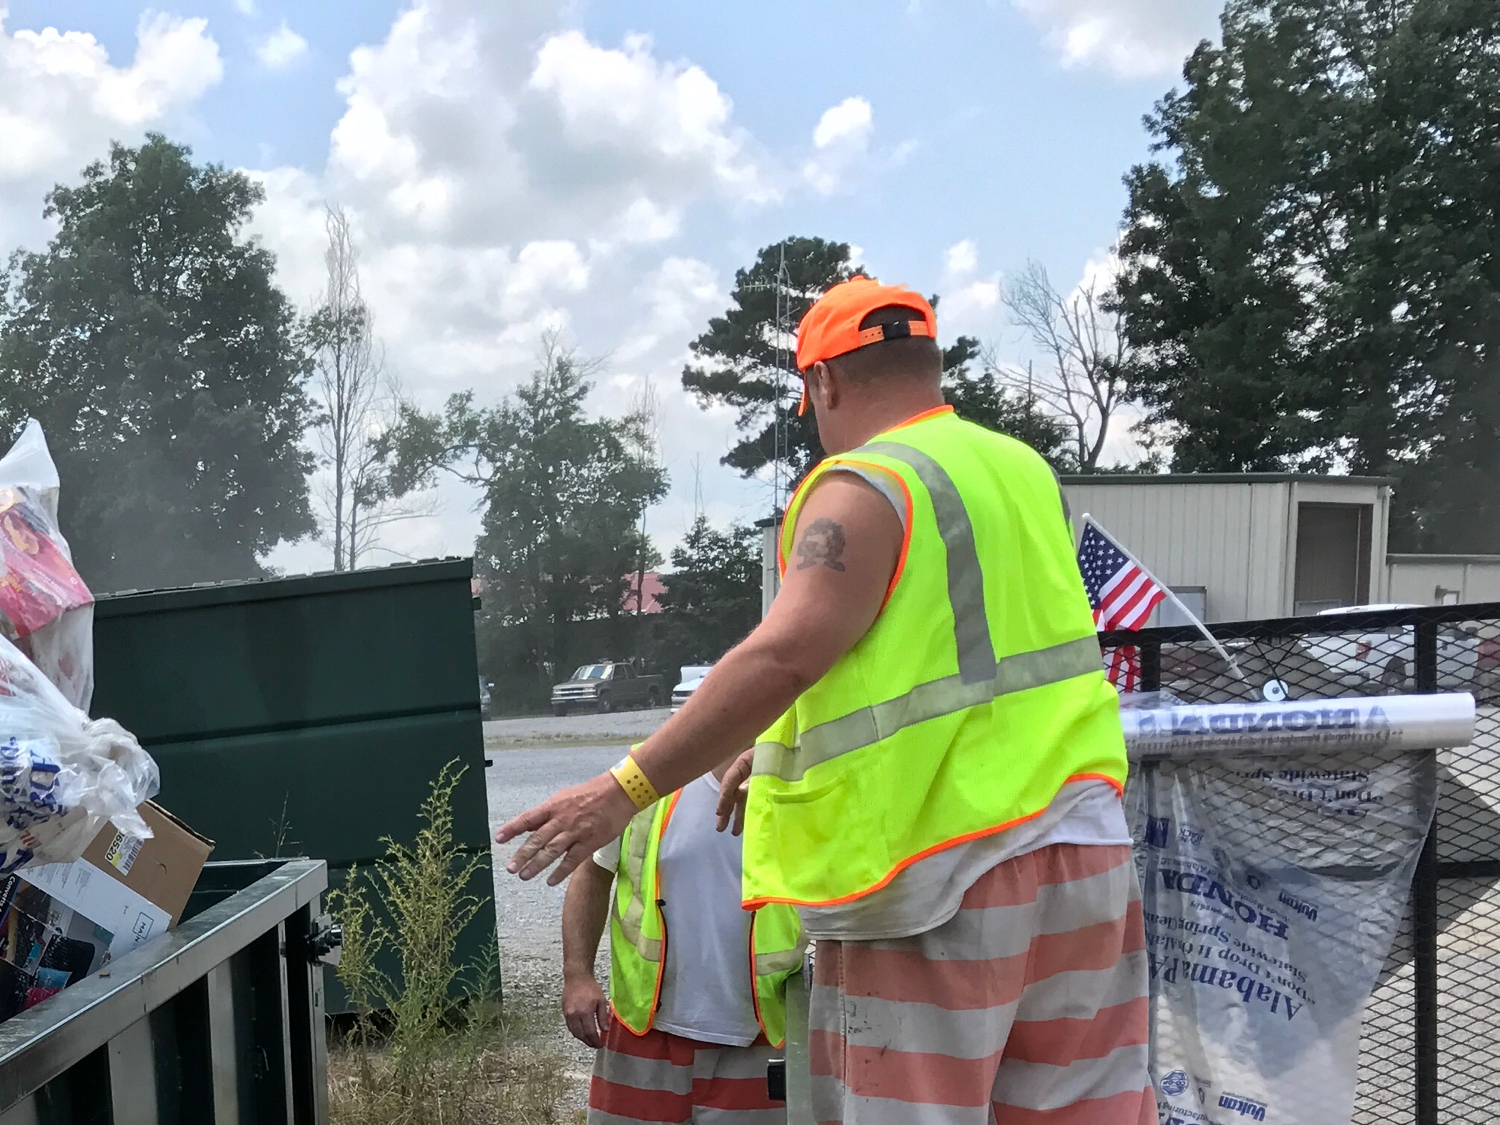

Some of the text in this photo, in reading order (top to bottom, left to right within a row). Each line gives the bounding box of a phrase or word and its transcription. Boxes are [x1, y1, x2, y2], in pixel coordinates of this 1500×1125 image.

[1159, 868, 1289, 941] HONDA
[1217, 948, 1261, 976] Drop
[1182, 961, 1304, 1022] Alabama
[1218, 1095, 1266, 1122] Vulcan
